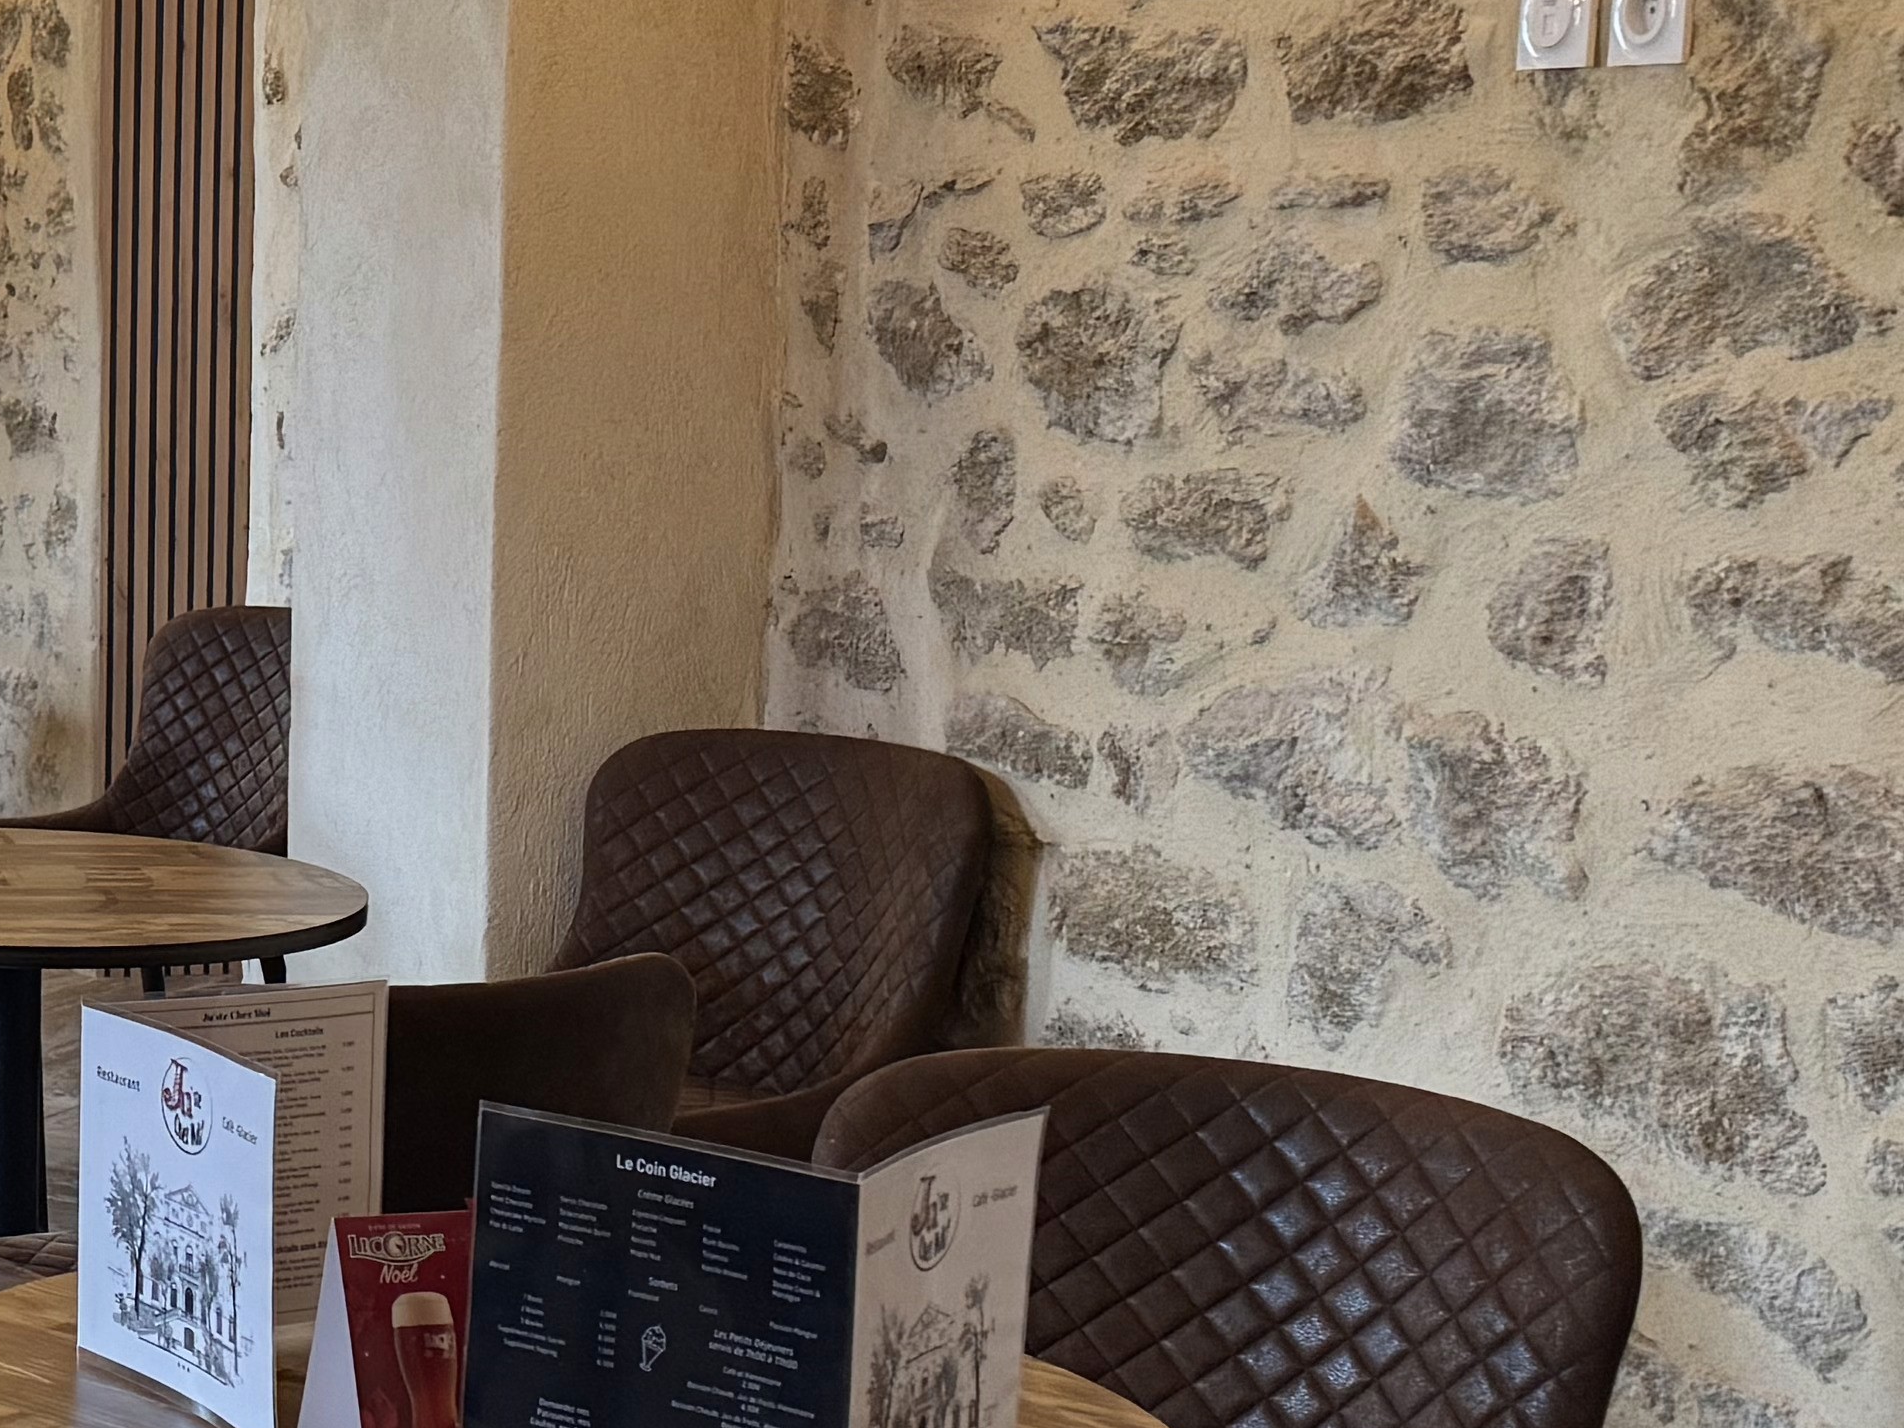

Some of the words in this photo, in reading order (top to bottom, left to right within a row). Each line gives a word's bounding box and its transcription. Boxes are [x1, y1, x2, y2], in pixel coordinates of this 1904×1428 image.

[97, 1065, 140, 1092] Restaurant
[616, 1154, 634, 1171] Le
[636, 1158, 667, 1177] Coin
[669, 1165, 717, 1188] Glacier
[347, 1231, 446, 1265] LICORNE
[379, 1262, 419, 1284] Noël
